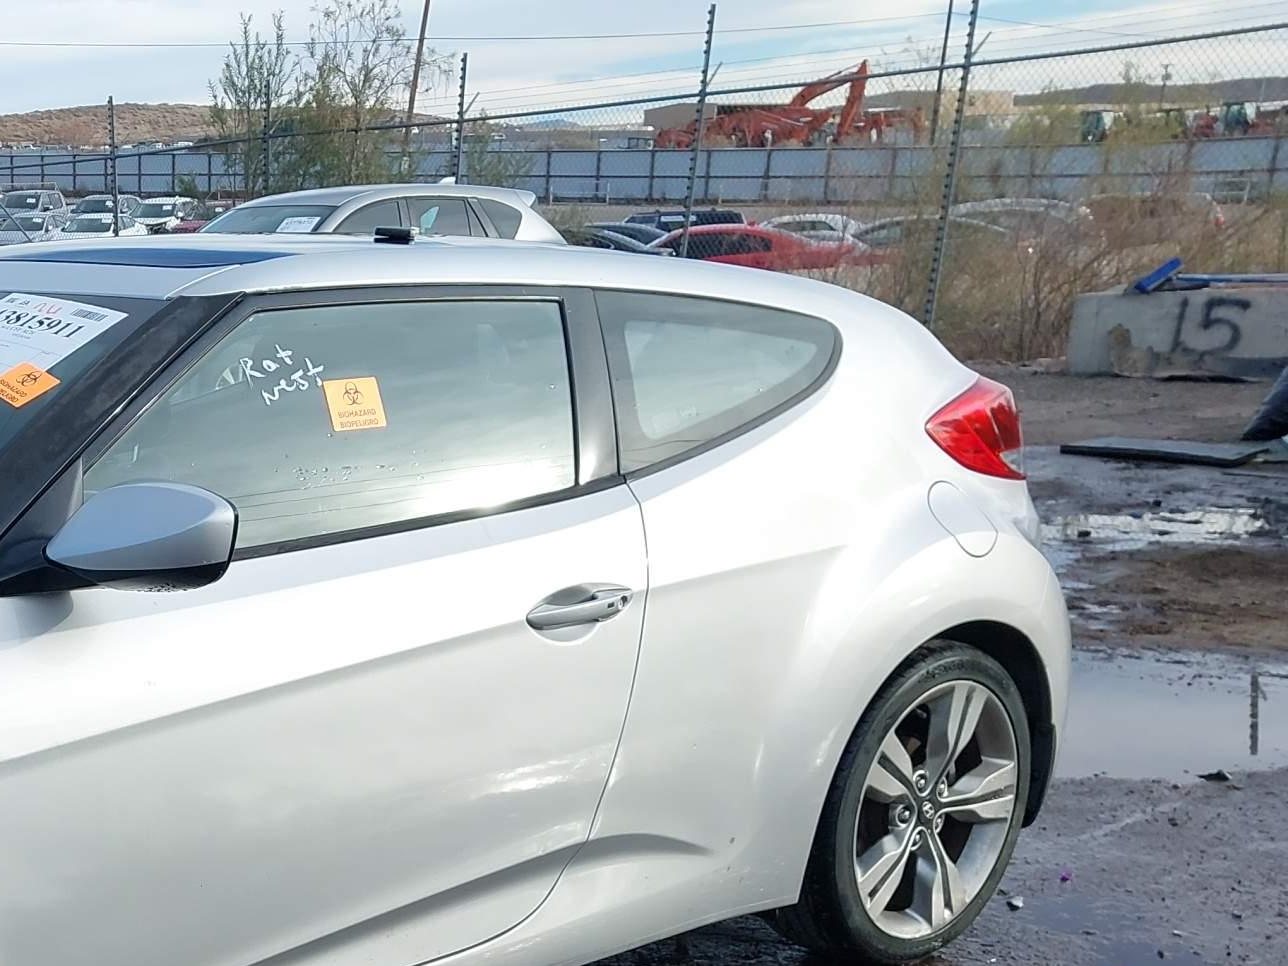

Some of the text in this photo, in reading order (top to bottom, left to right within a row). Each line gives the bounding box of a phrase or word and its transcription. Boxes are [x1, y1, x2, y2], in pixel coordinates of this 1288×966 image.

[1171, 296, 1252, 353] 15
[239, 343, 294, 390] Rat
[337, 408, 376, 418] BIOHAZARD
[339, 418, 379, 428] BIOPELIGRO
